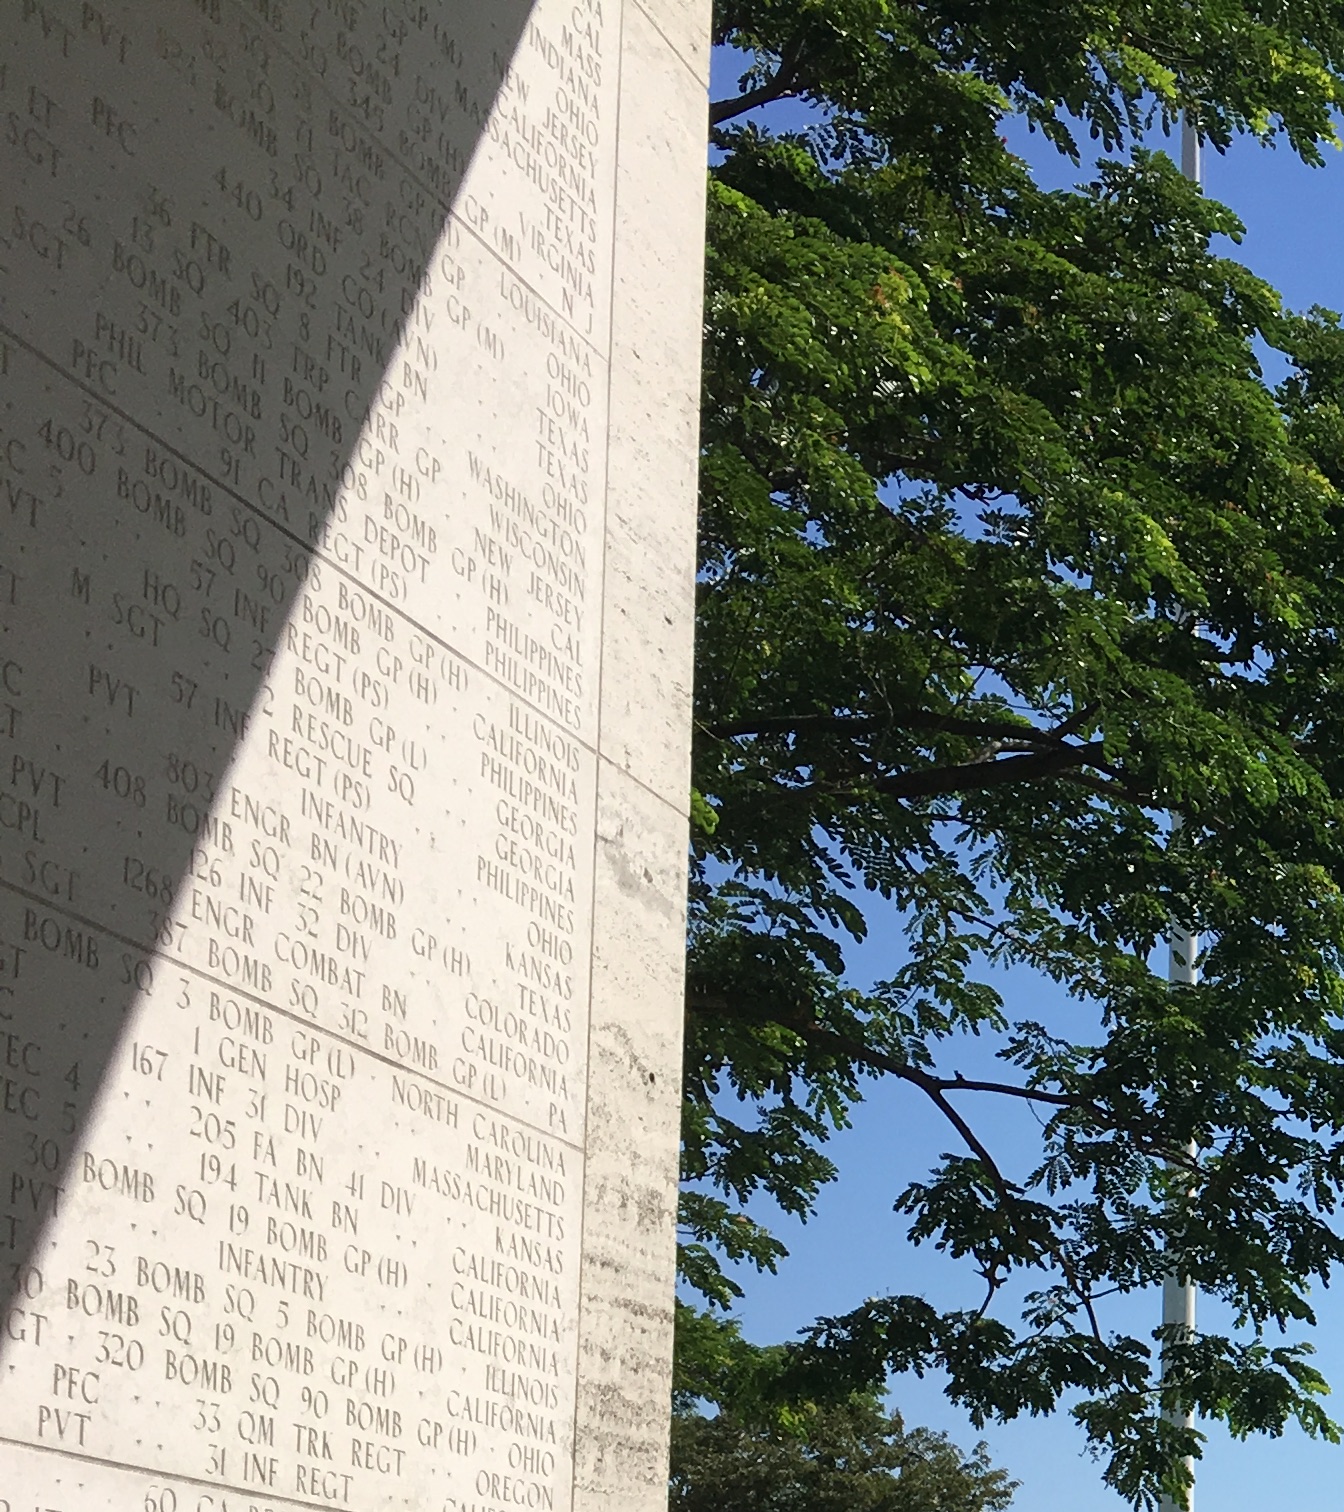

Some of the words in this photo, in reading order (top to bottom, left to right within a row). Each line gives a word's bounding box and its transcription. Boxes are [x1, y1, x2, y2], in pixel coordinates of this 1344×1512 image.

[274, 444, 348, 524] TRANS
[363, 512, 431, 585] DEPOT
[485, 604, 584, 699] PHILIPPINES
[261, 683, 275, 719] 2
[290, 702, 373, 780] RESCUE
[386, 763, 415, 808] SQ
[494, 837, 575, 904] GEORGIA
[300, 786, 399, 871] INFANTRY
[526, 919, 574, 967] OHIO
[238, 870, 275, 916] INF
[296, 901, 320, 941] 32
[335, 921, 372, 964] DIV
[464, 990, 570, 1066] COLORADO
[273, 930, 367, 1000] COMBAT
[380, 982, 407, 1022] BN
[460, 1024, 573, 1102] CALIFORNIA
[131, 1041, 169, 1083] 167
[187, 1062, 227, 1107] INF
[244, 1091, 268, 1124] 31
[283, 1101, 324, 1144] DIV
[411, 1155, 565, 1243] MASSACHUSETTS
[188, 1103, 237, 1151] 205
[252, 1129, 277, 1169] FA
[295, 1146, 324, 1186] BN
[344, 1169, 365, 1202] 41
[379, 1179, 414, 1218] DIV
[494, 1224, 564, 1276] KANSAS
[217, 1035, 267, 1084] GEN
[283, 1062, 342, 1114] HOSP
[464, 1142, 566, 1207] MARYLAND
[199, 1150, 238, 1193] 194
[253, 1169, 314, 1222] TANK
[330, 1199, 359, 1237] BN
[451, 1245, 564, 1315] CALIFORNIA
[218, 1238, 329, 1303] INFANTRY
[448, 1316, 559, 1379] CALIFORNIA
[36, 1403, 93, 1448] PVT
[207, 1442, 227, 1477] 31
[242, 1450, 280, 1488] INF
[295, 1462, 355, 1504] REGT
[51, 1361, 101, 1406] PFC
[192, 1397, 222, 1432] 33
[236, 1409, 275, 1448] QM
[291, 1421, 334, 1462] TRK
[350, 1436, 407, 1478] REGT
[474, 1468, 554, 1512] OREGON
